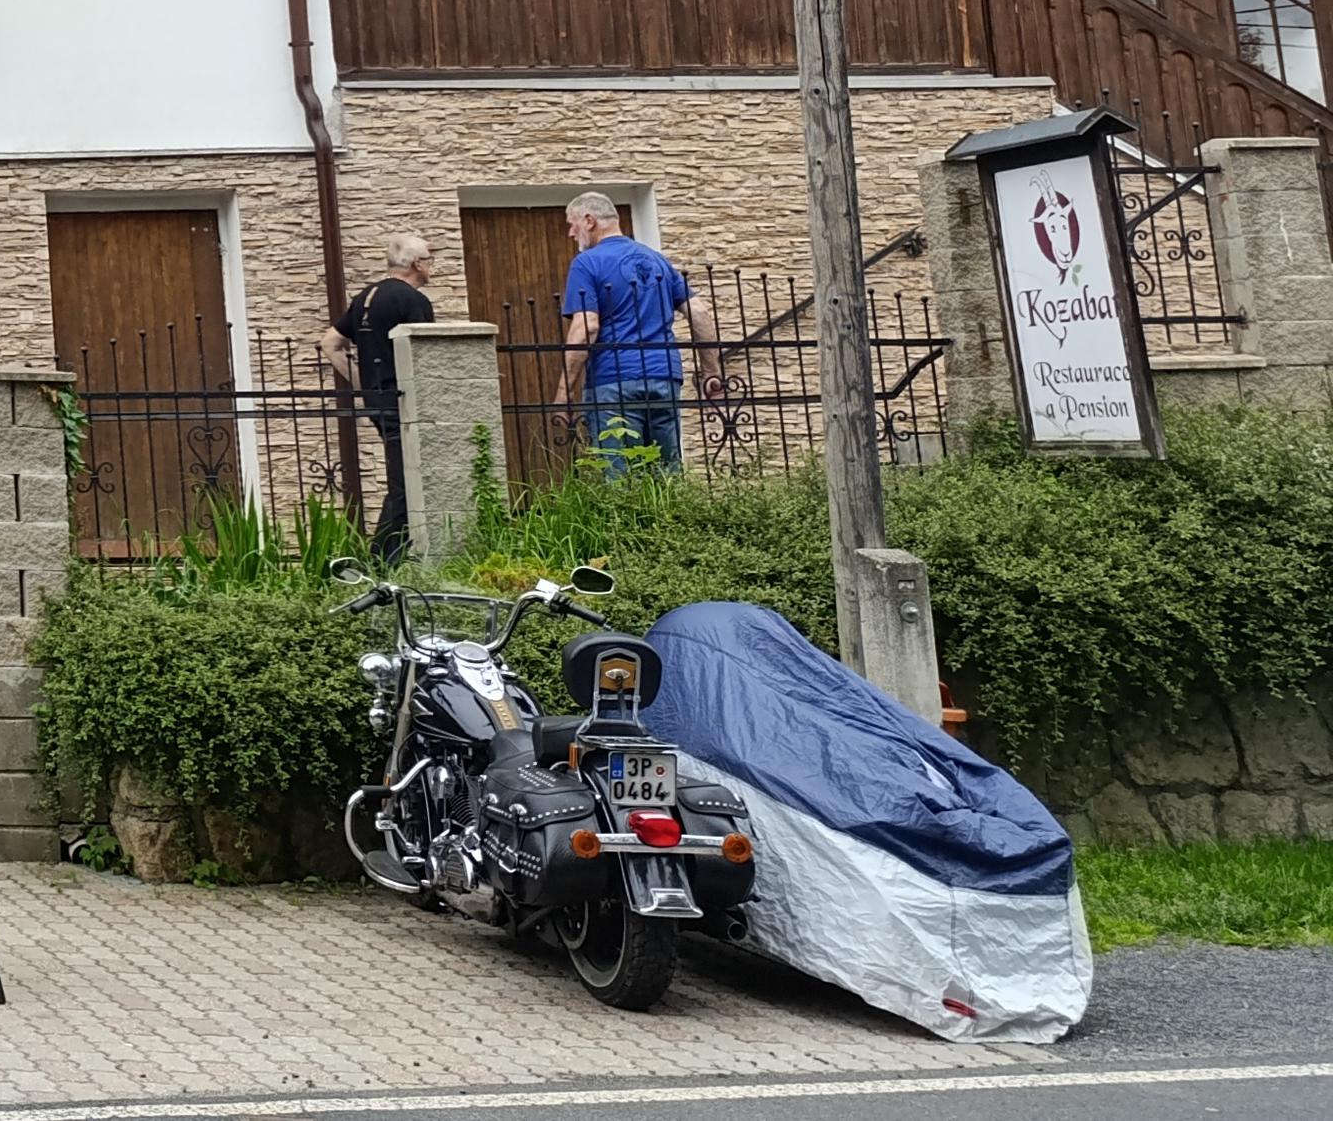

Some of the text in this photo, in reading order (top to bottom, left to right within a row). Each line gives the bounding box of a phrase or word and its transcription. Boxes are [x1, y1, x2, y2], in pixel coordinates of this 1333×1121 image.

[1017, 284, 1119, 349] Kozaba
[1045, 395, 1130, 421] a Pension
[627, 757, 652, 777] 3P
[613, 781, 667, 801] 0484
